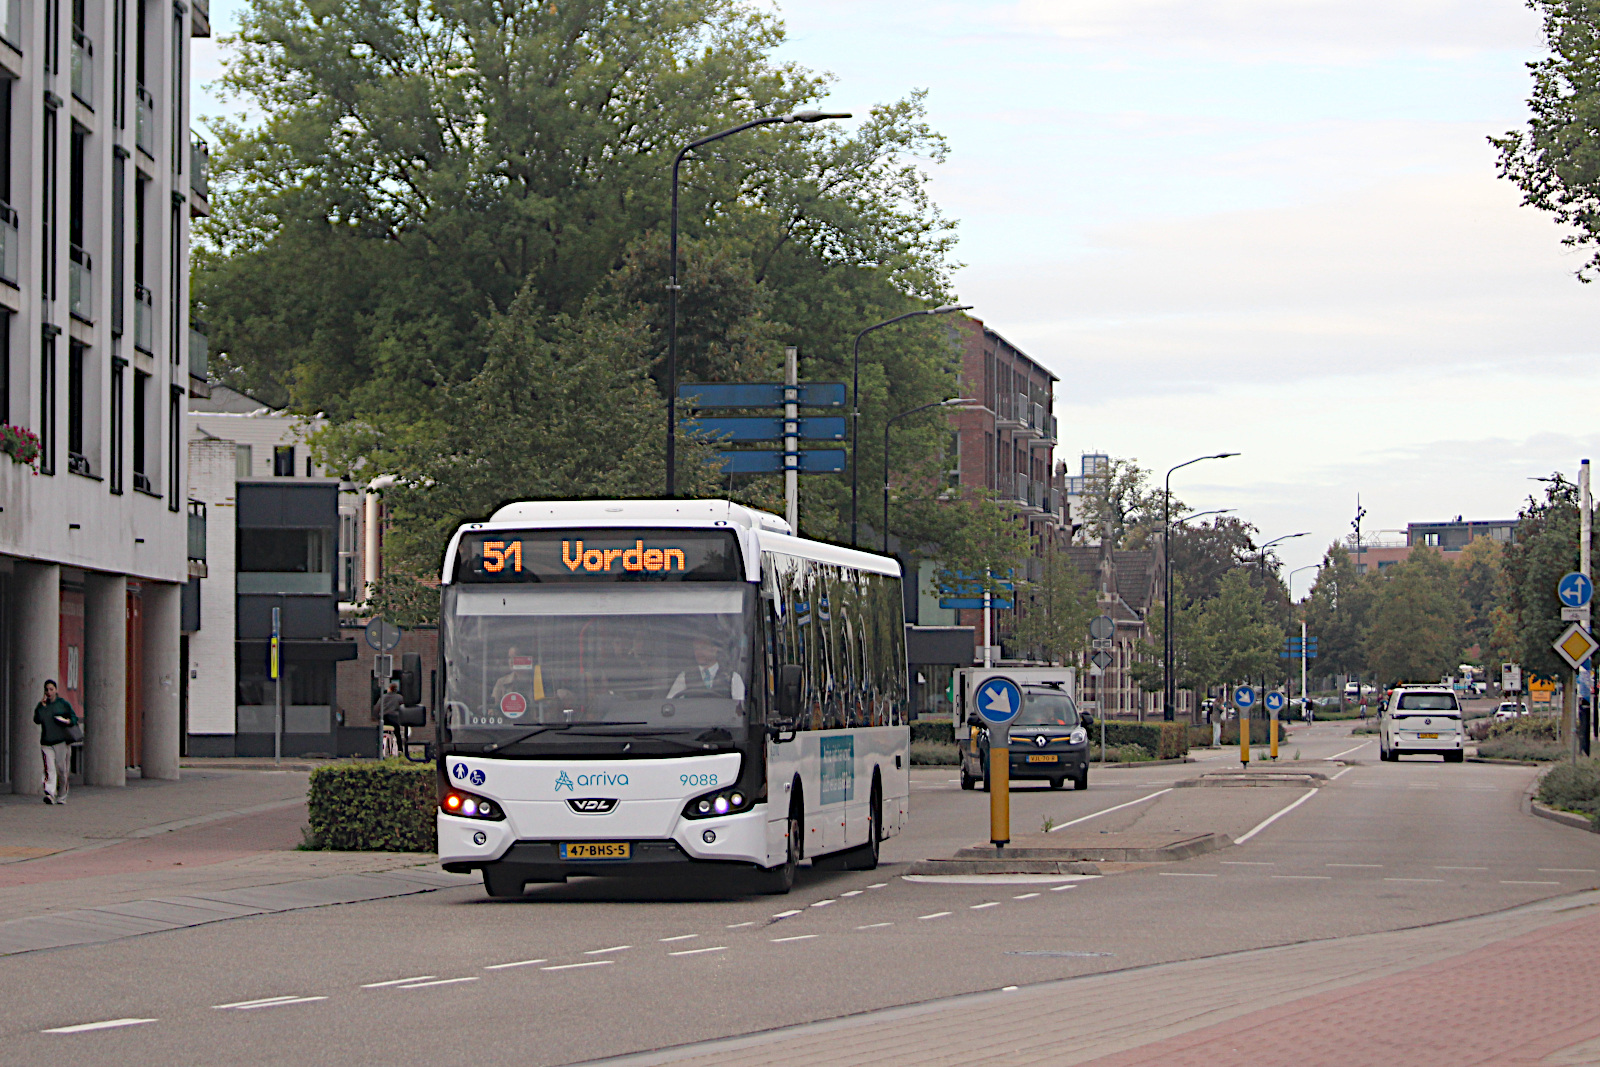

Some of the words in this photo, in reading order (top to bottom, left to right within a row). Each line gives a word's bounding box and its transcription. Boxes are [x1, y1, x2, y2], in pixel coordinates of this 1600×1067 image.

[483, 541, 523, 573] 51
[561, 539, 686, 572] Vorden
[577, 770, 630, 787] arriva
[679, 773, 719, 787] 9088
[573, 800, 611, 810] VDL
[570, 844, 626, 857] 47-BHS-5
